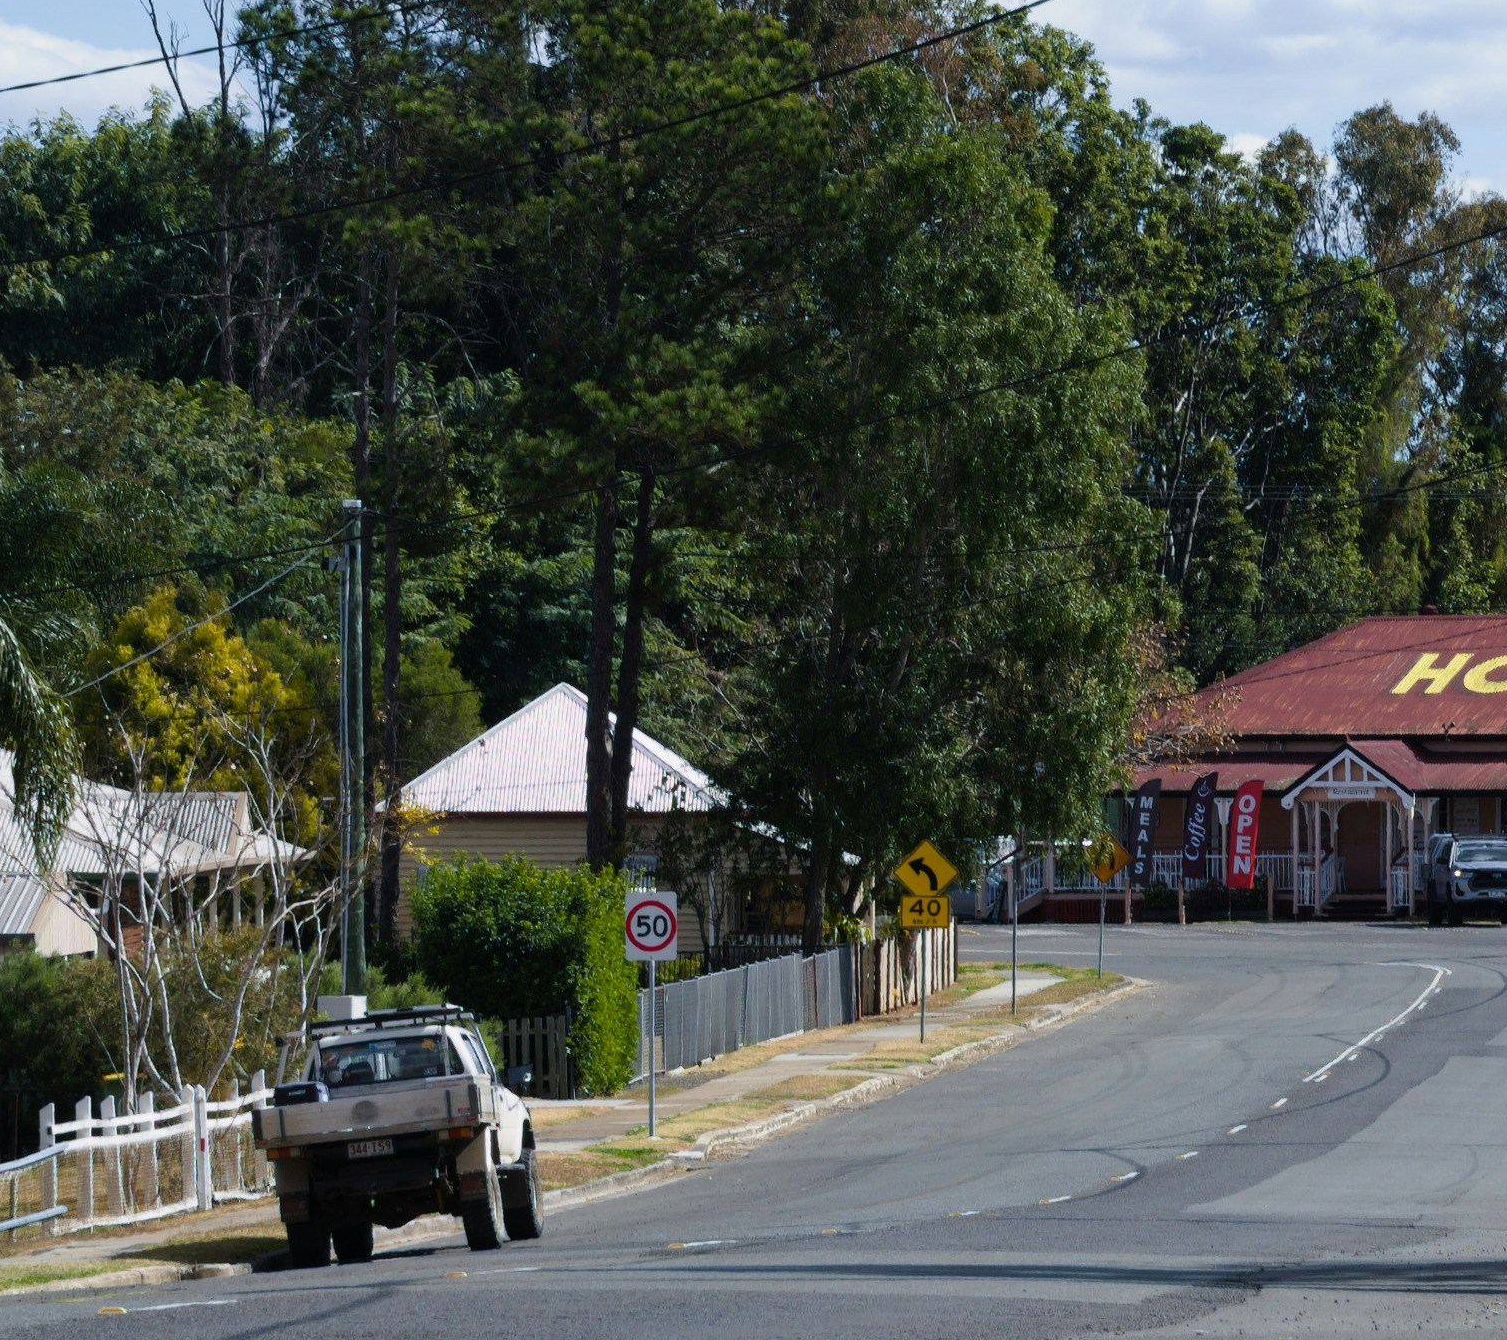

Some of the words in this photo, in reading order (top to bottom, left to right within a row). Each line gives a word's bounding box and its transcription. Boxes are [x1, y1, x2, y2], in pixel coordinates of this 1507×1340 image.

[1134, 796, 1154, 874] MEALS
[1184, 802, 1206, 861] Coffee
[1232, 794, 1257, 875] OPEN
[636, 915, 668, 937] 50
[909, 899, 941, 916] 40
